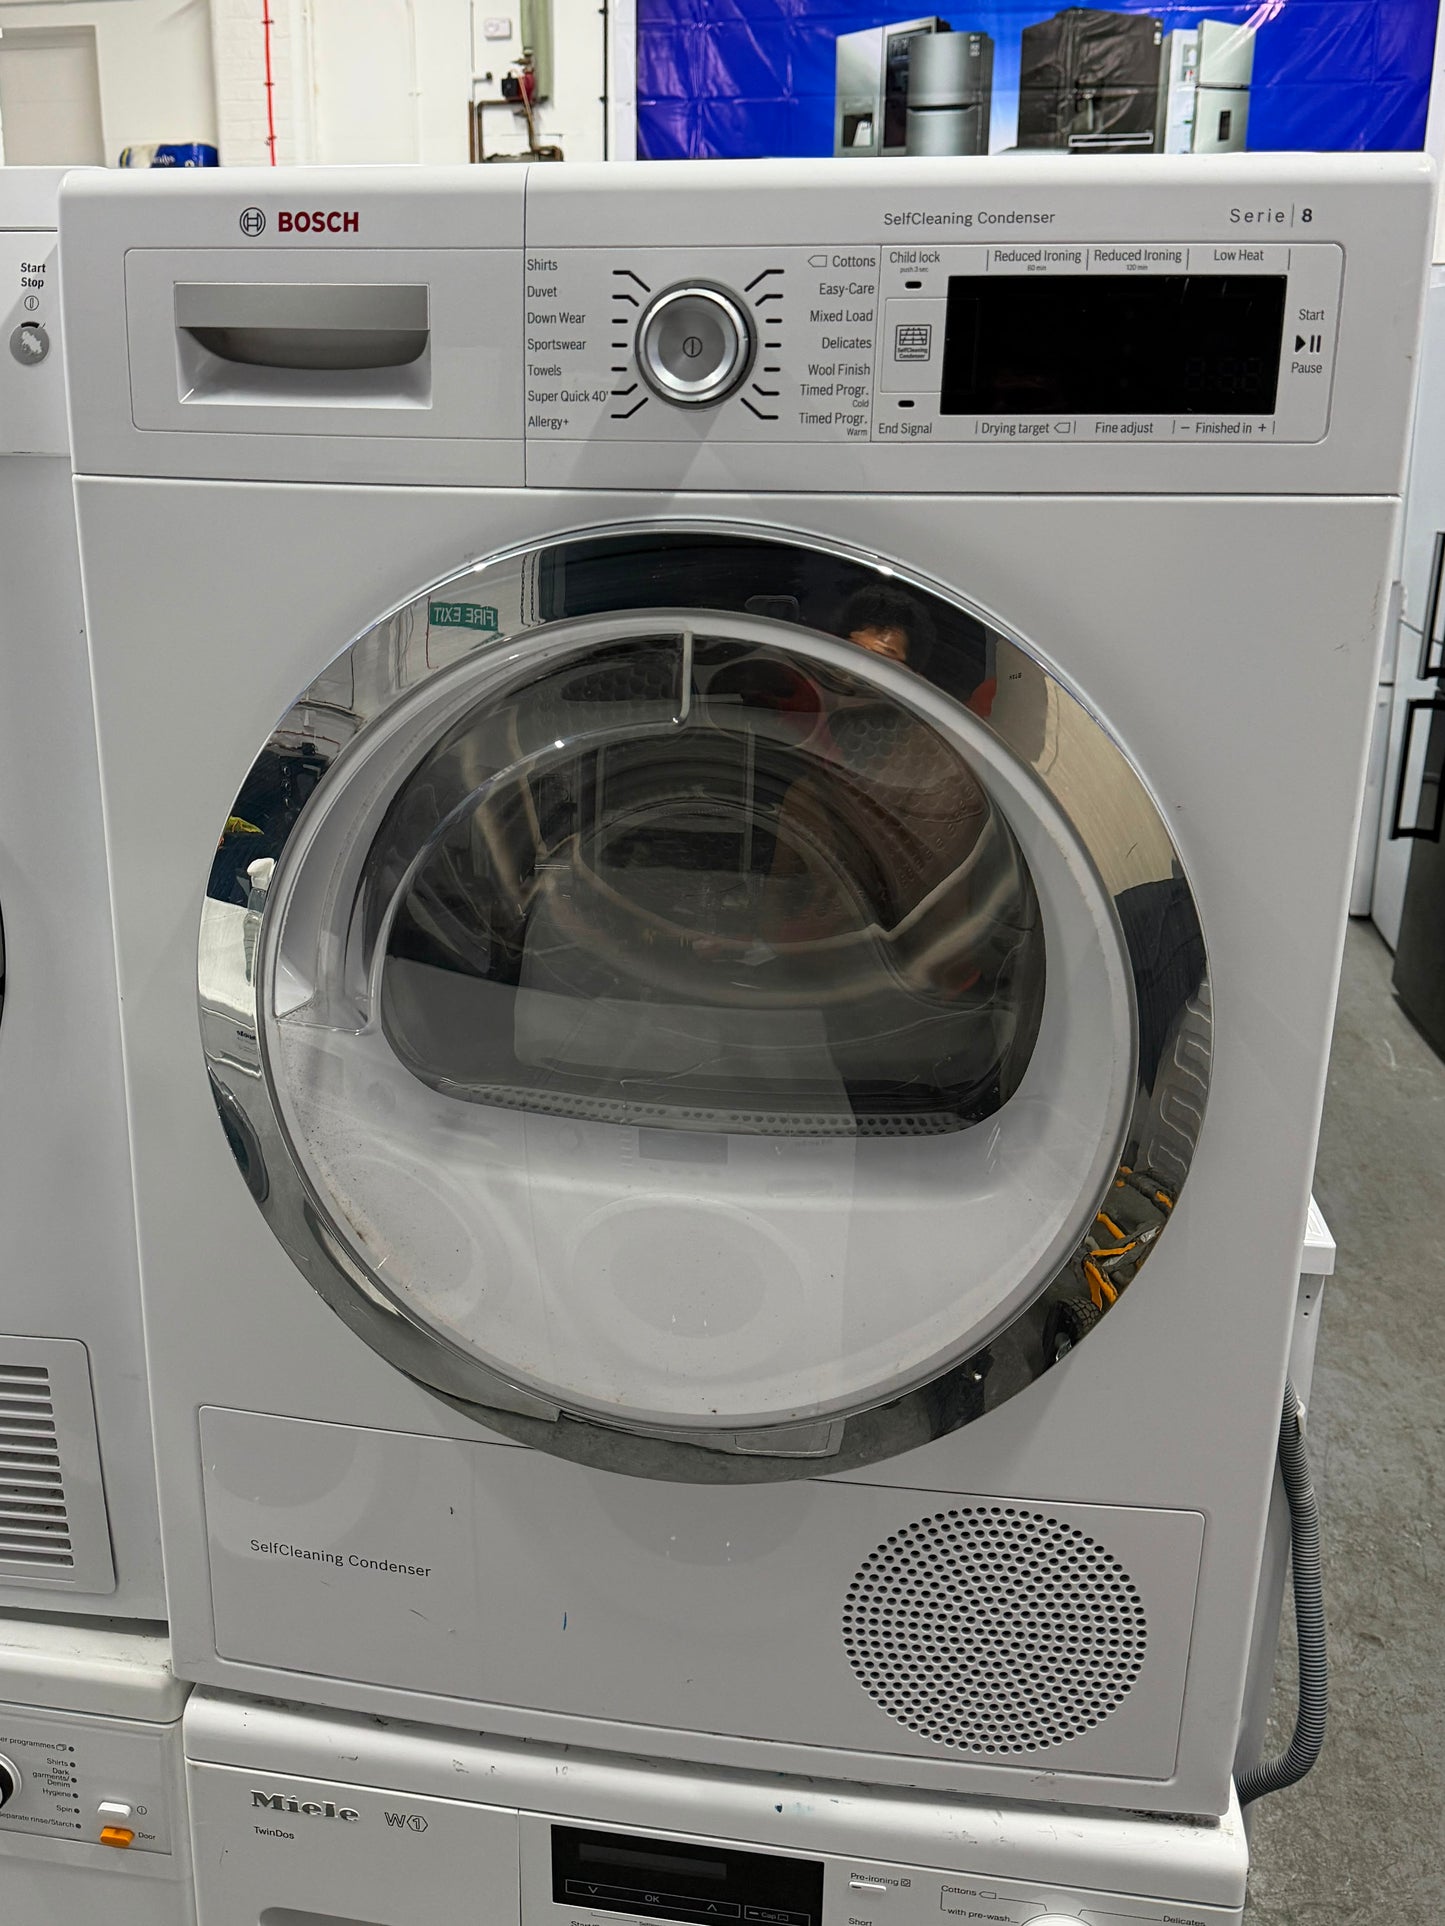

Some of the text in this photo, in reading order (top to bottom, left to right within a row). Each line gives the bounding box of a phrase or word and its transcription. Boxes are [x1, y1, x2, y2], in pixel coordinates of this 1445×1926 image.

[278, 211, 360, 233] BOSCH
[884, 210, 1055, 227] SelfCleaning Condenser
[1230, 208, 1313, 224] Serie 8
[832, 255, 876, 267] Cottons
[890, 250, 941, 263] Child lock
[994, 249, 1081, 264] Reduced Ironing
[1094, 249, 1182, 263] Reduced Ironing
[1213, 249, 1264, 262] Low Heat
[20, 262, 46, 274] Start
[527, 259, 558, 271] Shirts
[21, 276, 45, 289] Stop
[819, 282, 875, 296] Easy-Care
[527, 285, 558, 298] Duvet
[527, 312, 586, 324] Down Wear
[810, 309, 873, 322] Mixed Load
[1298, 309, 1324, 321] Start
[527, 338, 586, 351] Sportswear
[822, 337, 872, 349] Delicates
[527, 364, 562, 376] Towels
[808, 363, 871, 375] Wool Finish
[1291, 362, 1323, 374] Pause
[528, 391, 557, 403] Super
[561, 390, 589, 403] Quick
[800, 384, 869, 399] Timed Progr.
[852, 399, 869, 408] Cold
[528, 415, 569, 430] Allergy+
[799, 412, 868, 427] Timed Progr.
[847, 428, 868, 436] Warm
[878, 422, 932, 436] End Signal
[982, 421, 1049, 437] Drying target
[1095, 422, 1153, 436] Fine adjust
[1195, 421, 1252, 434] Finished in
[250, 1539, 432, 1577] SelfCleaning Condenser
[10, 1738, 56, 1750] programmes
[46, 1757, 69, 1767] Shirts
[52, 1767, 70, 1775] Dark
[47, 1779, 71, 1788] Denim
[42, 1788, 72, 1797] Hygiene
[56, 1804, 73, 1813] Spin
[250, 1788, 361, 1822] Miele
[138, 1831, 156, 1841] Door
[254, 1826, 295, 1840] TwinDos
[850, 1872, 900, 1887] Pre-ironing
[941, 1884, 977, 1897] Cottons
[645, 1894, 660, 1904] OK
[761, 1911, 777, 1920] Cap
[947, 1907, 1011, 1923] with pre-wash
